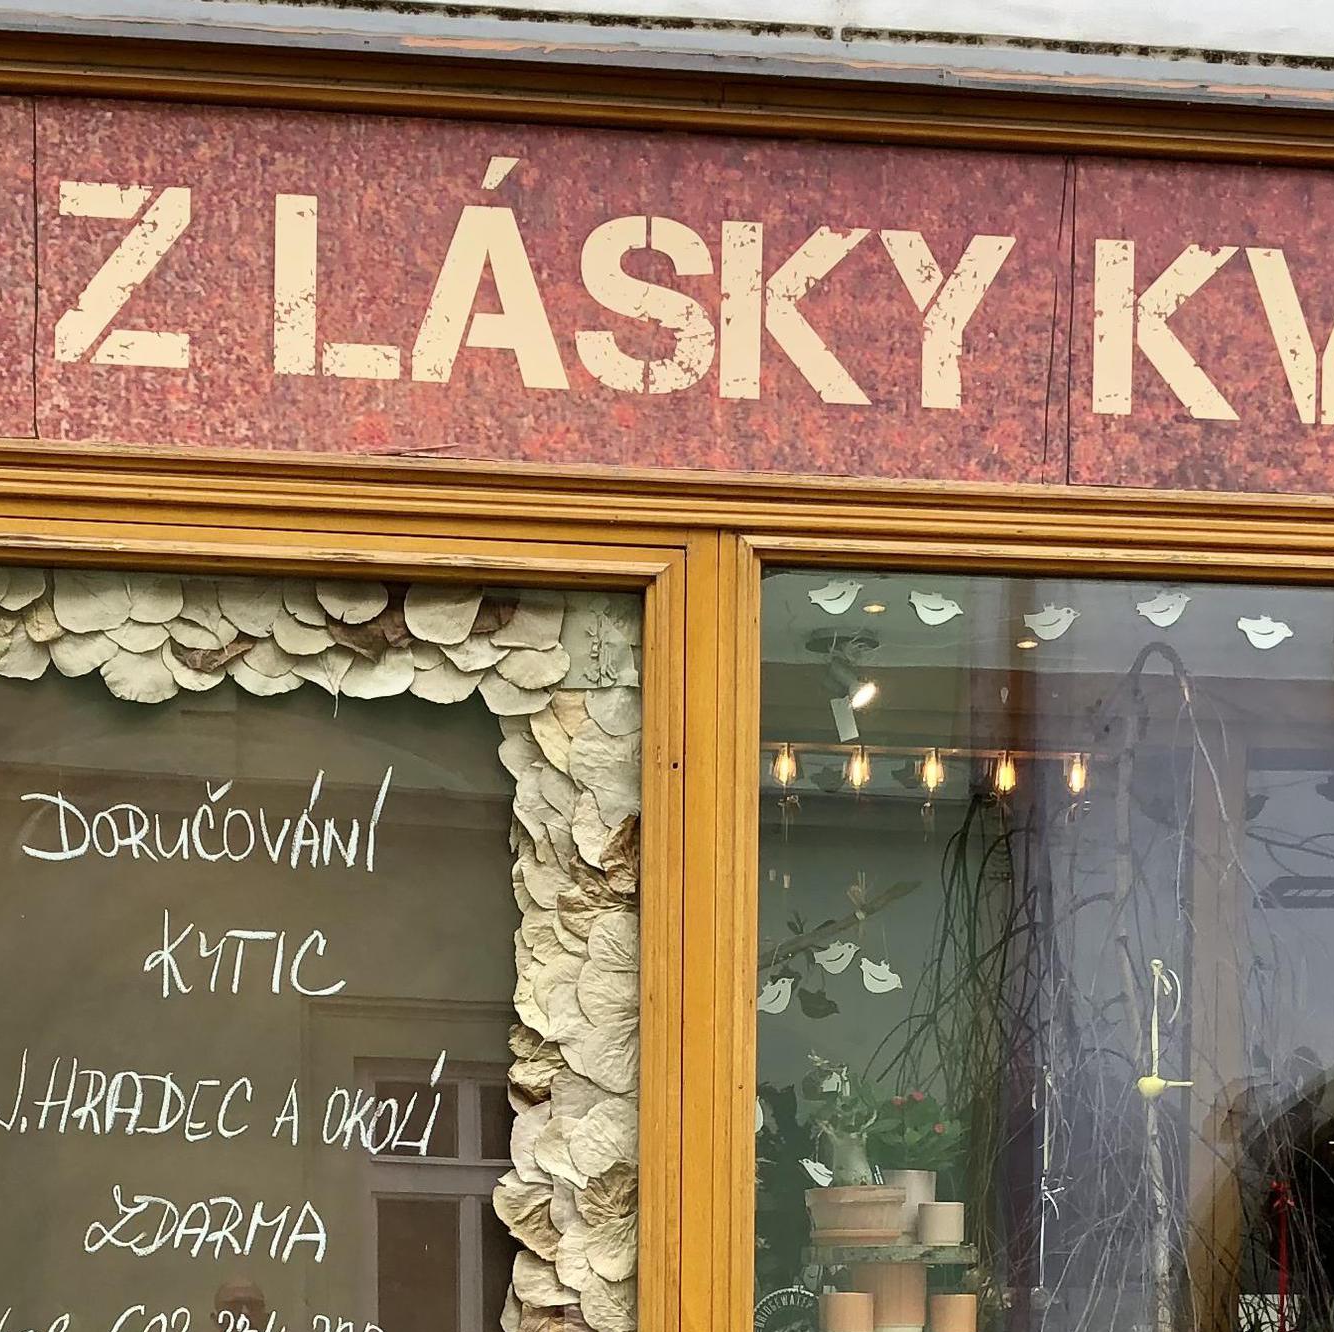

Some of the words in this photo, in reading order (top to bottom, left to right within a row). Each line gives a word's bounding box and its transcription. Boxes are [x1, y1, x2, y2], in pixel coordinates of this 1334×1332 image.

[54, 180, 192, 369] Z
[272, 156, 1017, 410] LÁSKY
[21, 766, 392, 871] DORUČOVÁNÍ
[144, 910, 345, 997] KYTIC
[272, 1079, 298, 1145] A
[323, 1049, 446, 1156] OKOLÍ
[85, 1185, 326, 1262] ZDARMA
